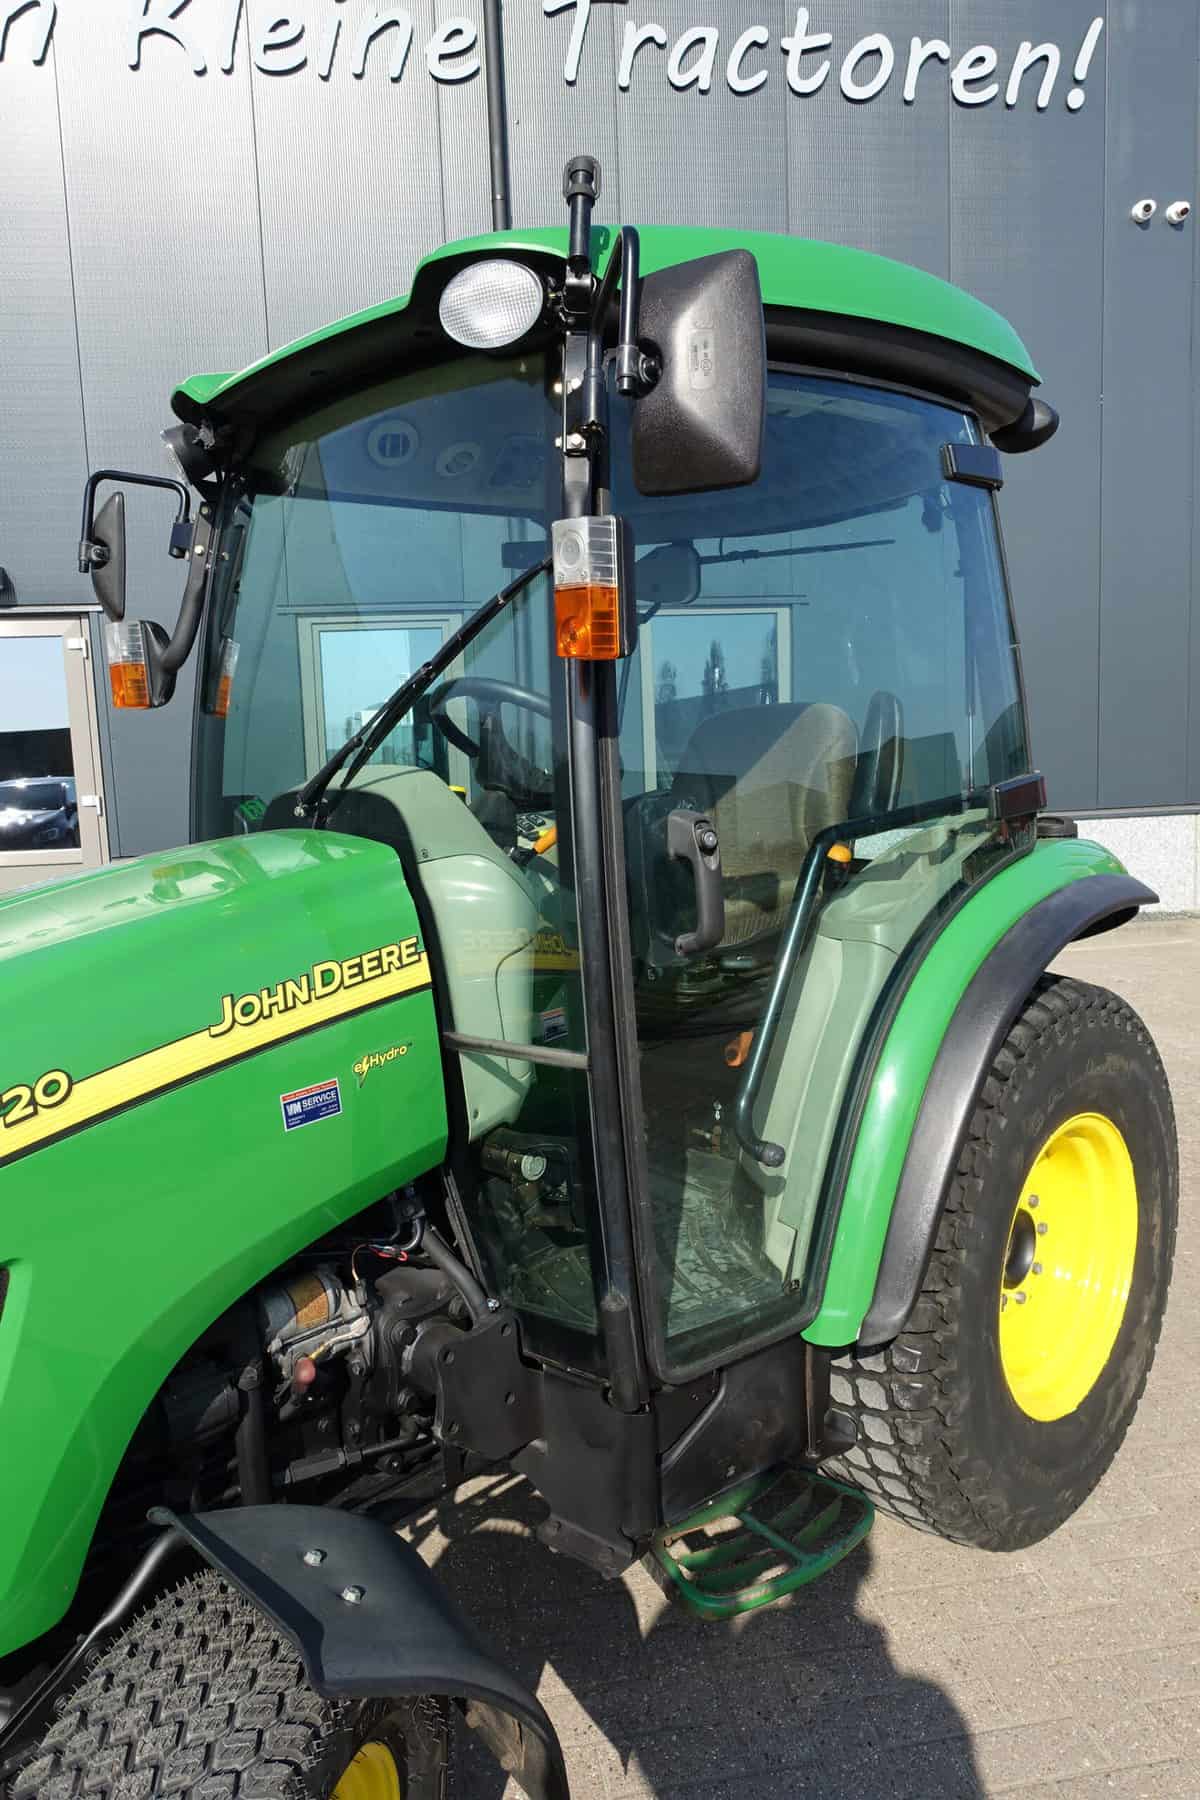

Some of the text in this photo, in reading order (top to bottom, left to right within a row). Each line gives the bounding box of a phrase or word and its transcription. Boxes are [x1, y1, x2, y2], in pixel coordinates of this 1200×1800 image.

[128, 0, 481, 84] Kleine
[543, 0, 1104, 110] Tractoren!
[209, 973, 312, 1038] JOHN
[312, 936, 420, 999] DEERE
[0, 1069, 72, 1128] 20
[302, 1089, 337, 1108] SERVICE
